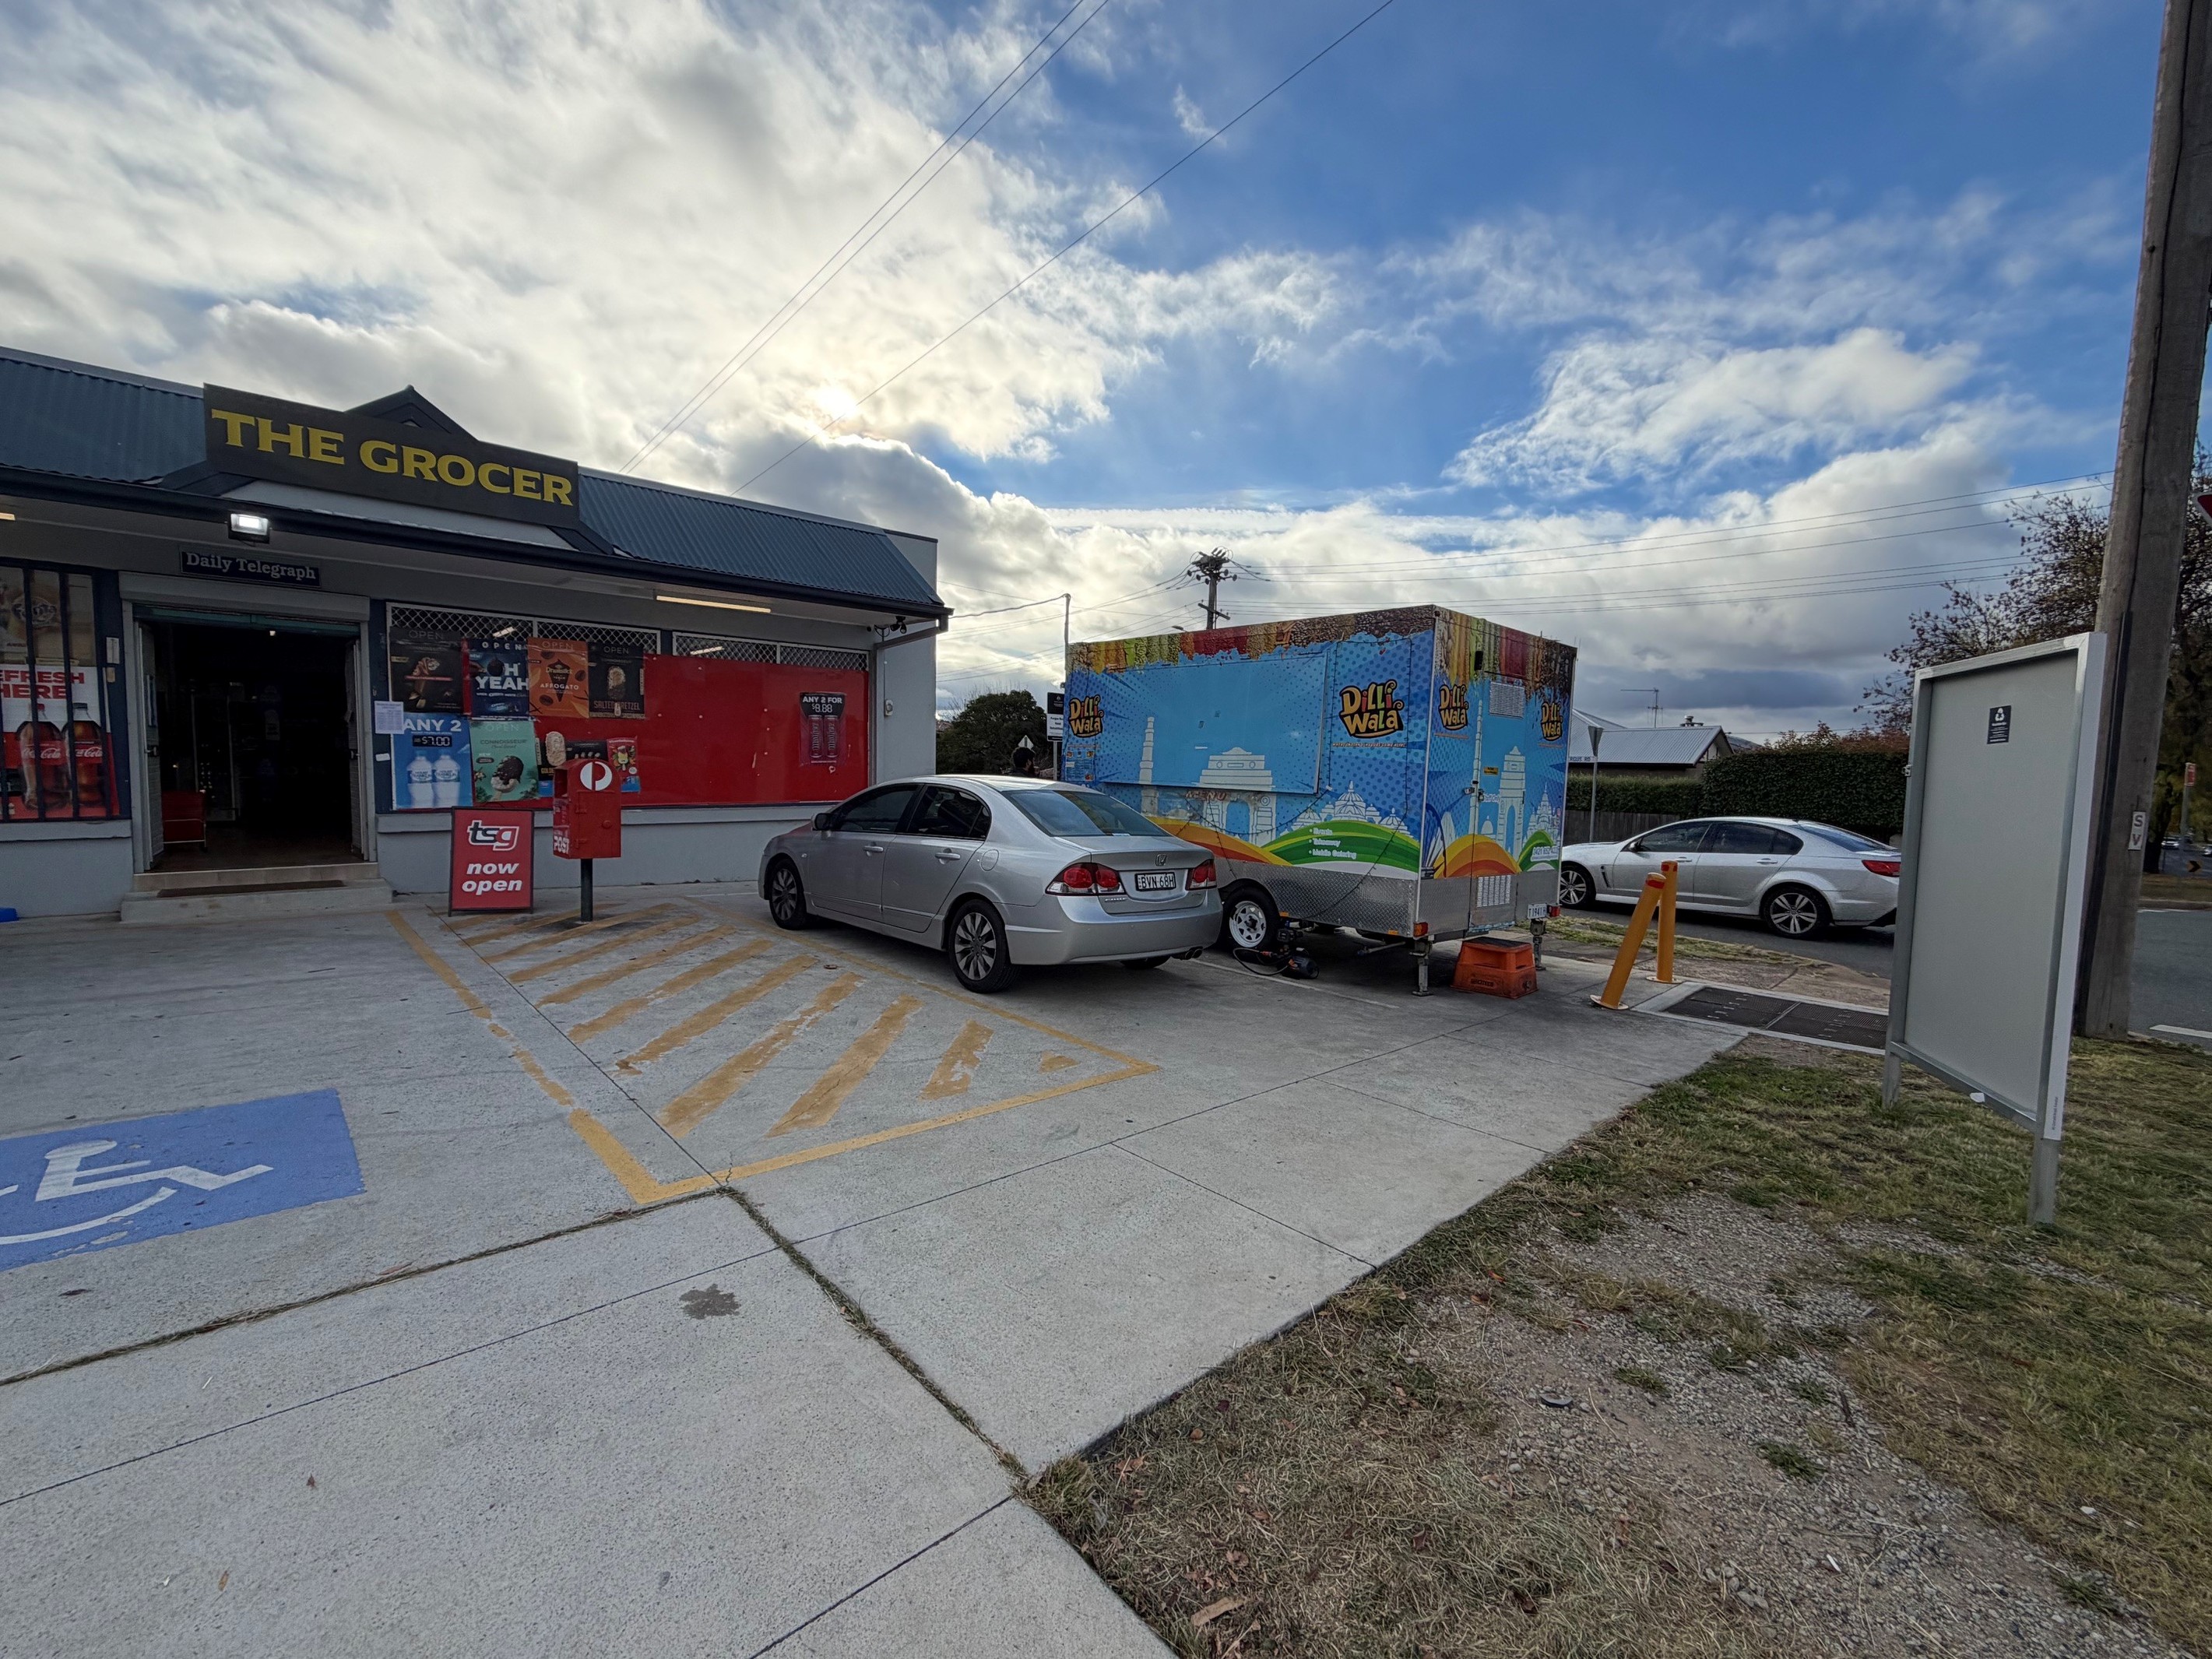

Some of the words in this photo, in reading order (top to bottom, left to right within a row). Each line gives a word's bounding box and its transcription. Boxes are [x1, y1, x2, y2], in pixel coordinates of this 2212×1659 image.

[210, 408, 345, 466] THE
[360, 439, 573, 507] GROCER
[186, 552, 231, 573] Daily
[237, 558, 316, 582] Telegraph
[409, 630, 443, 640] OPEN
[482, 641, 522, 651] OPEN
[542, 641, 574, 650] OPEN
[603, 646, 629, 655] OPEN
[475, 676, 529, 691] YEAH
[593, 701, 615, 709] SALTED
[403, 719, 445, 731] ANY
[450, 720, 462, 732] 2
[486, 723, 519, 732] OPEN
[421, 736, 450, 747] $7.00
[467, 820, 519, 851] tsg
[466, 863, 519, 874] now
[462, 880, 522, 895] open
